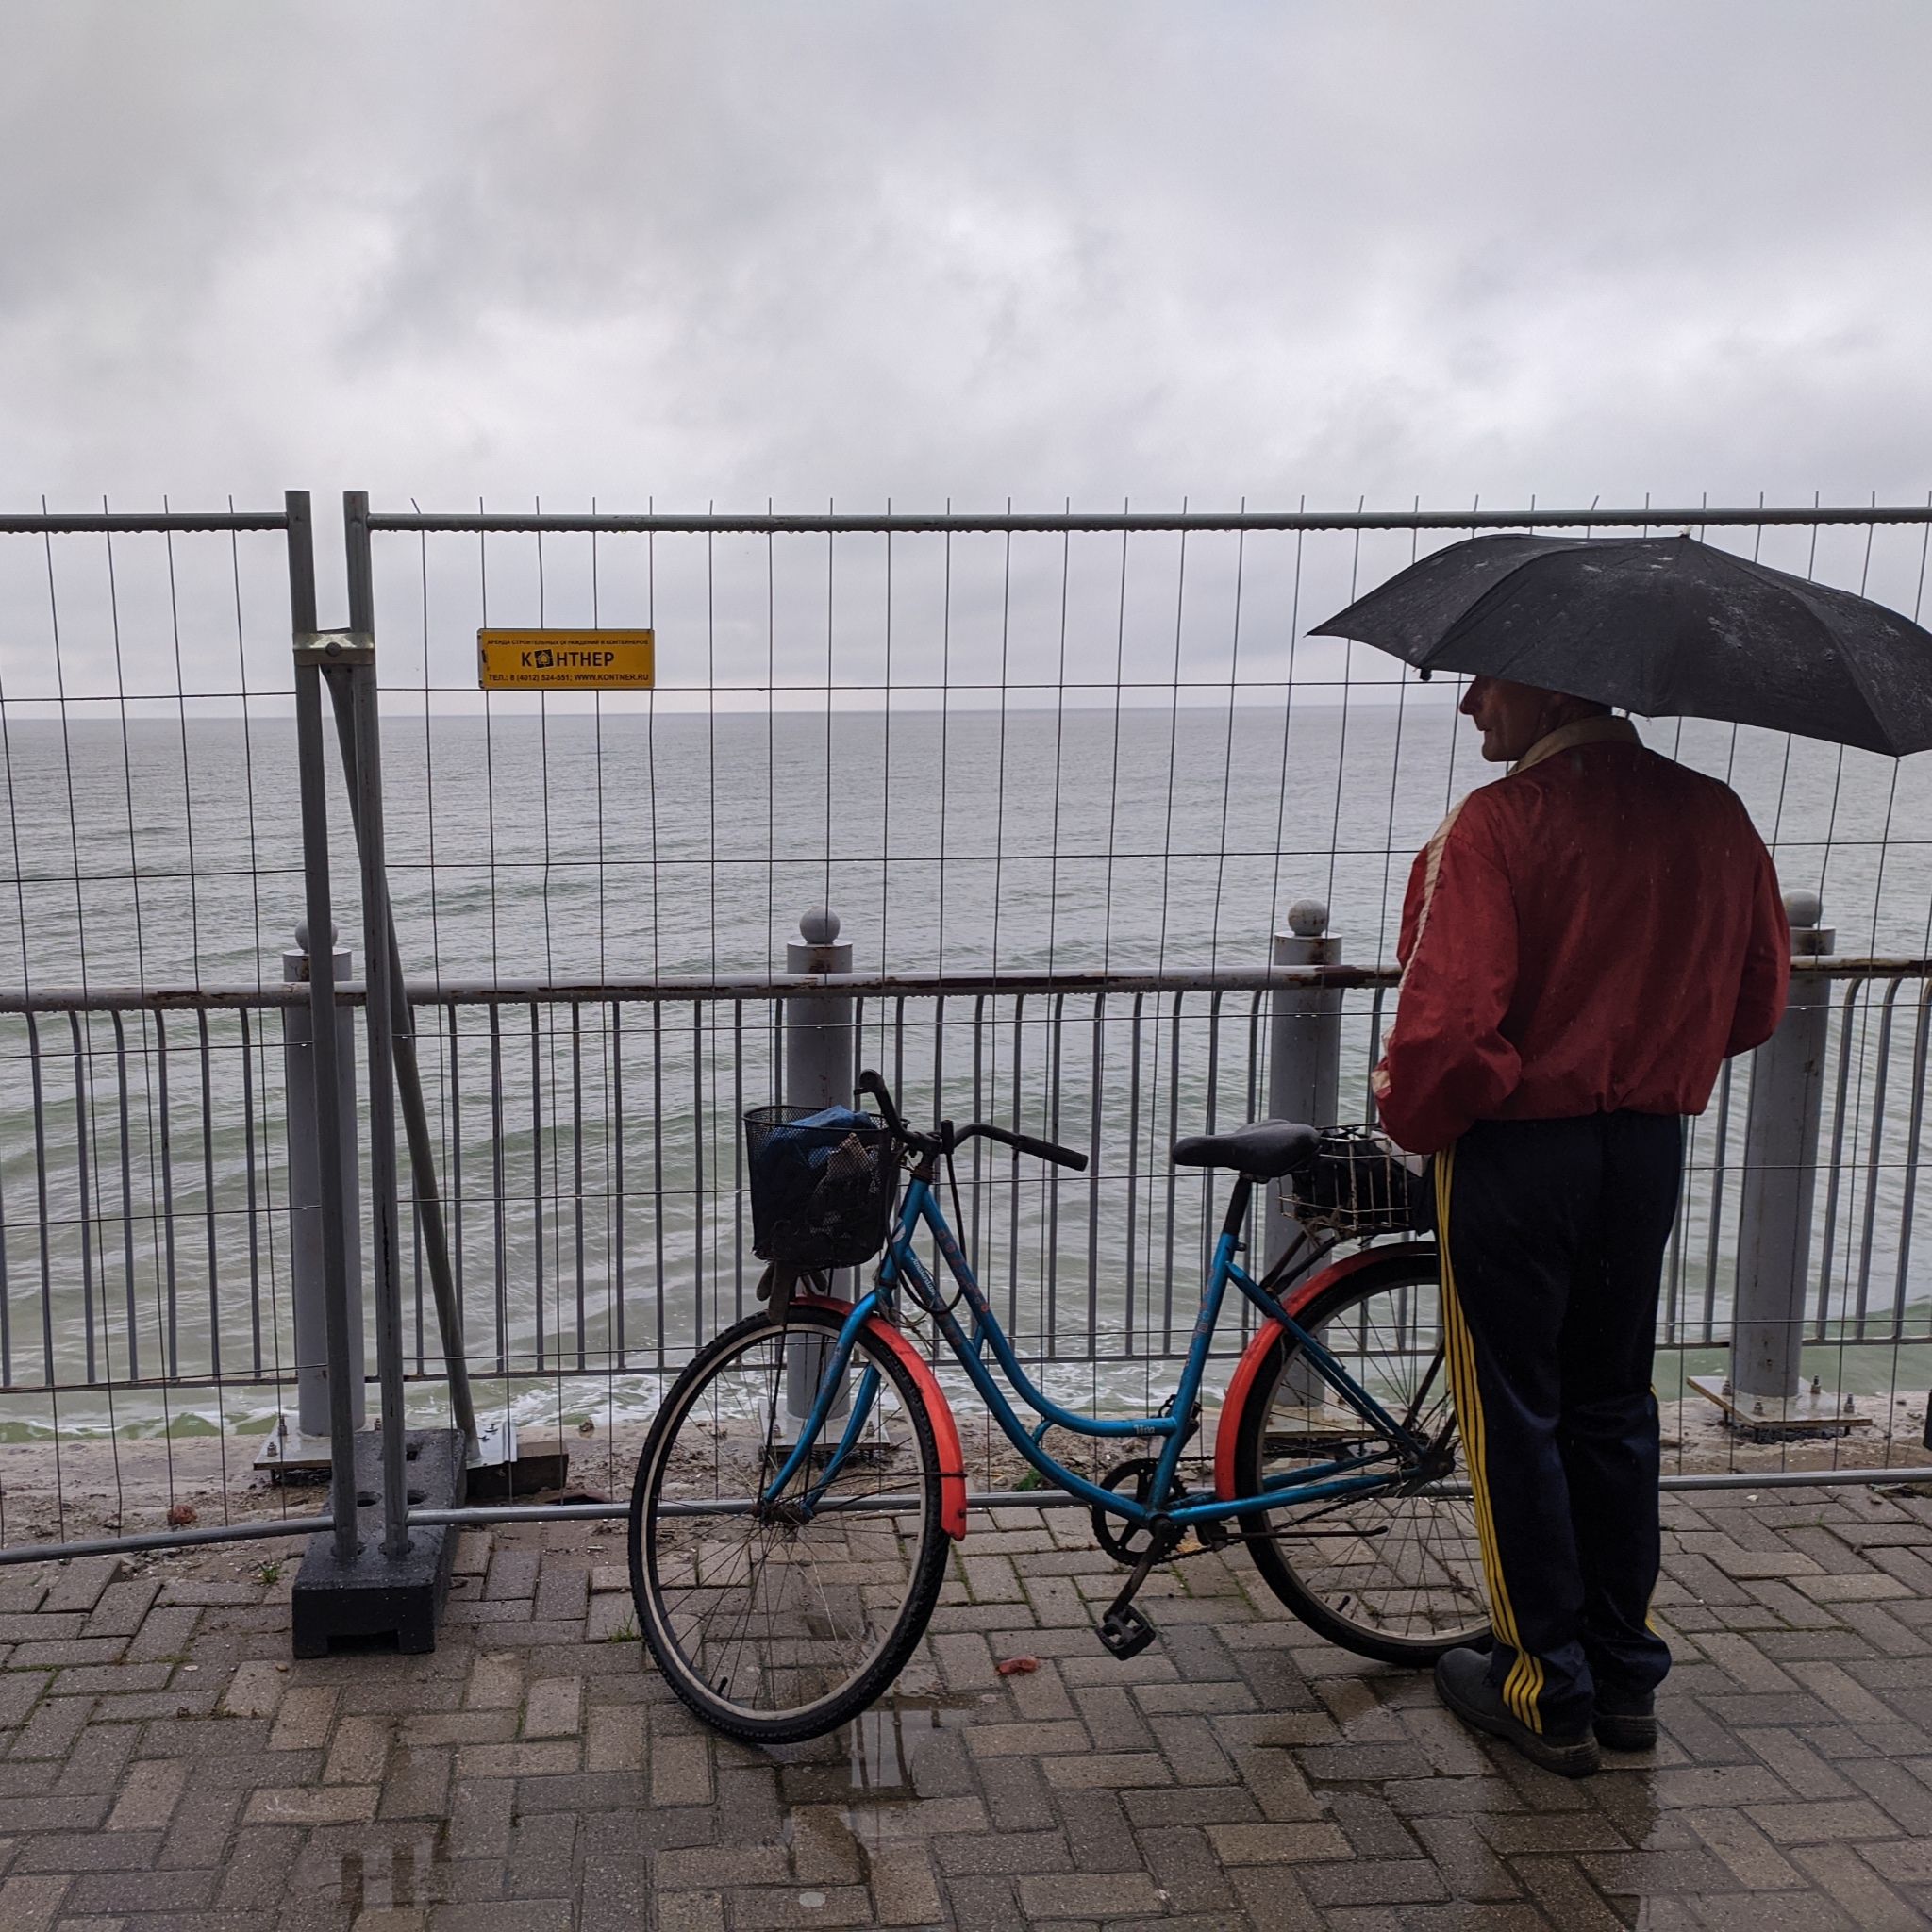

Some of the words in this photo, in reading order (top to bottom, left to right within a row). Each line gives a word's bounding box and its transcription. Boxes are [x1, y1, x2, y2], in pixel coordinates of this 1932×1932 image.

[516, 674, 540, 682] (4012)
[541, 674, 572, 682] 524-551;
[910, 1257, 935, 1296] Amsterdam
